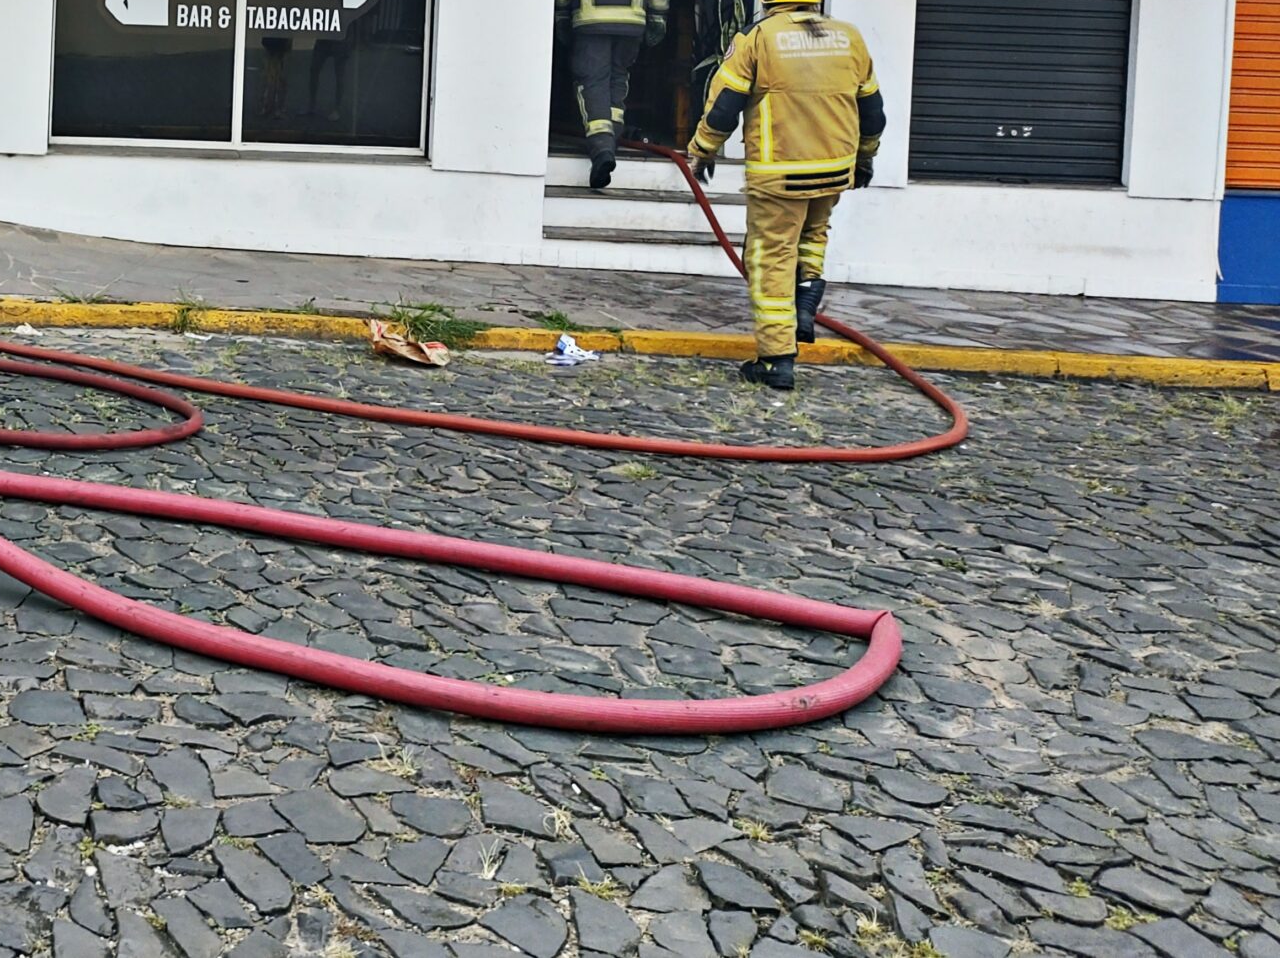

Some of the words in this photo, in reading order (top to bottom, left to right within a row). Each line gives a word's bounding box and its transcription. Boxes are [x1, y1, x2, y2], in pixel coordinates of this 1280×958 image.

[176, 4, 212, 28] BAR
[218, 7, 232, 28] &
[247, 6, 341, 32] TABACARIA
